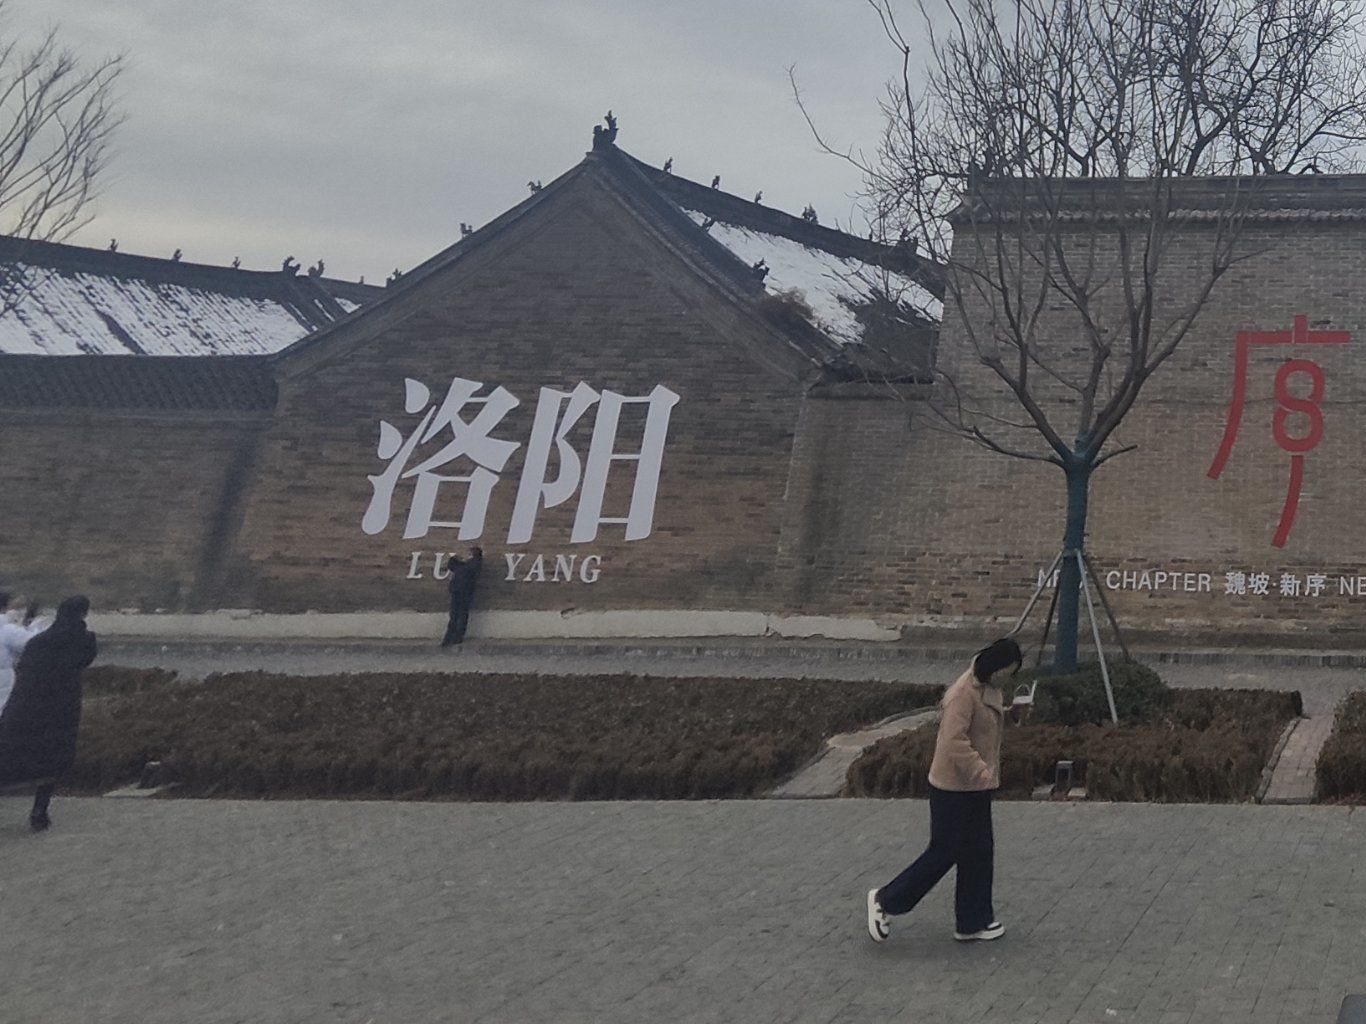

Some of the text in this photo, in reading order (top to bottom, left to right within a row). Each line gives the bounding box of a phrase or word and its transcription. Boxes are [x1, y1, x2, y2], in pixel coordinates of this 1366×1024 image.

[361, 377, 681, 544] 洛阳
[407, 551, 602, 583] LU YANG
[1106, 570, 1211, 592] CHAPTER
